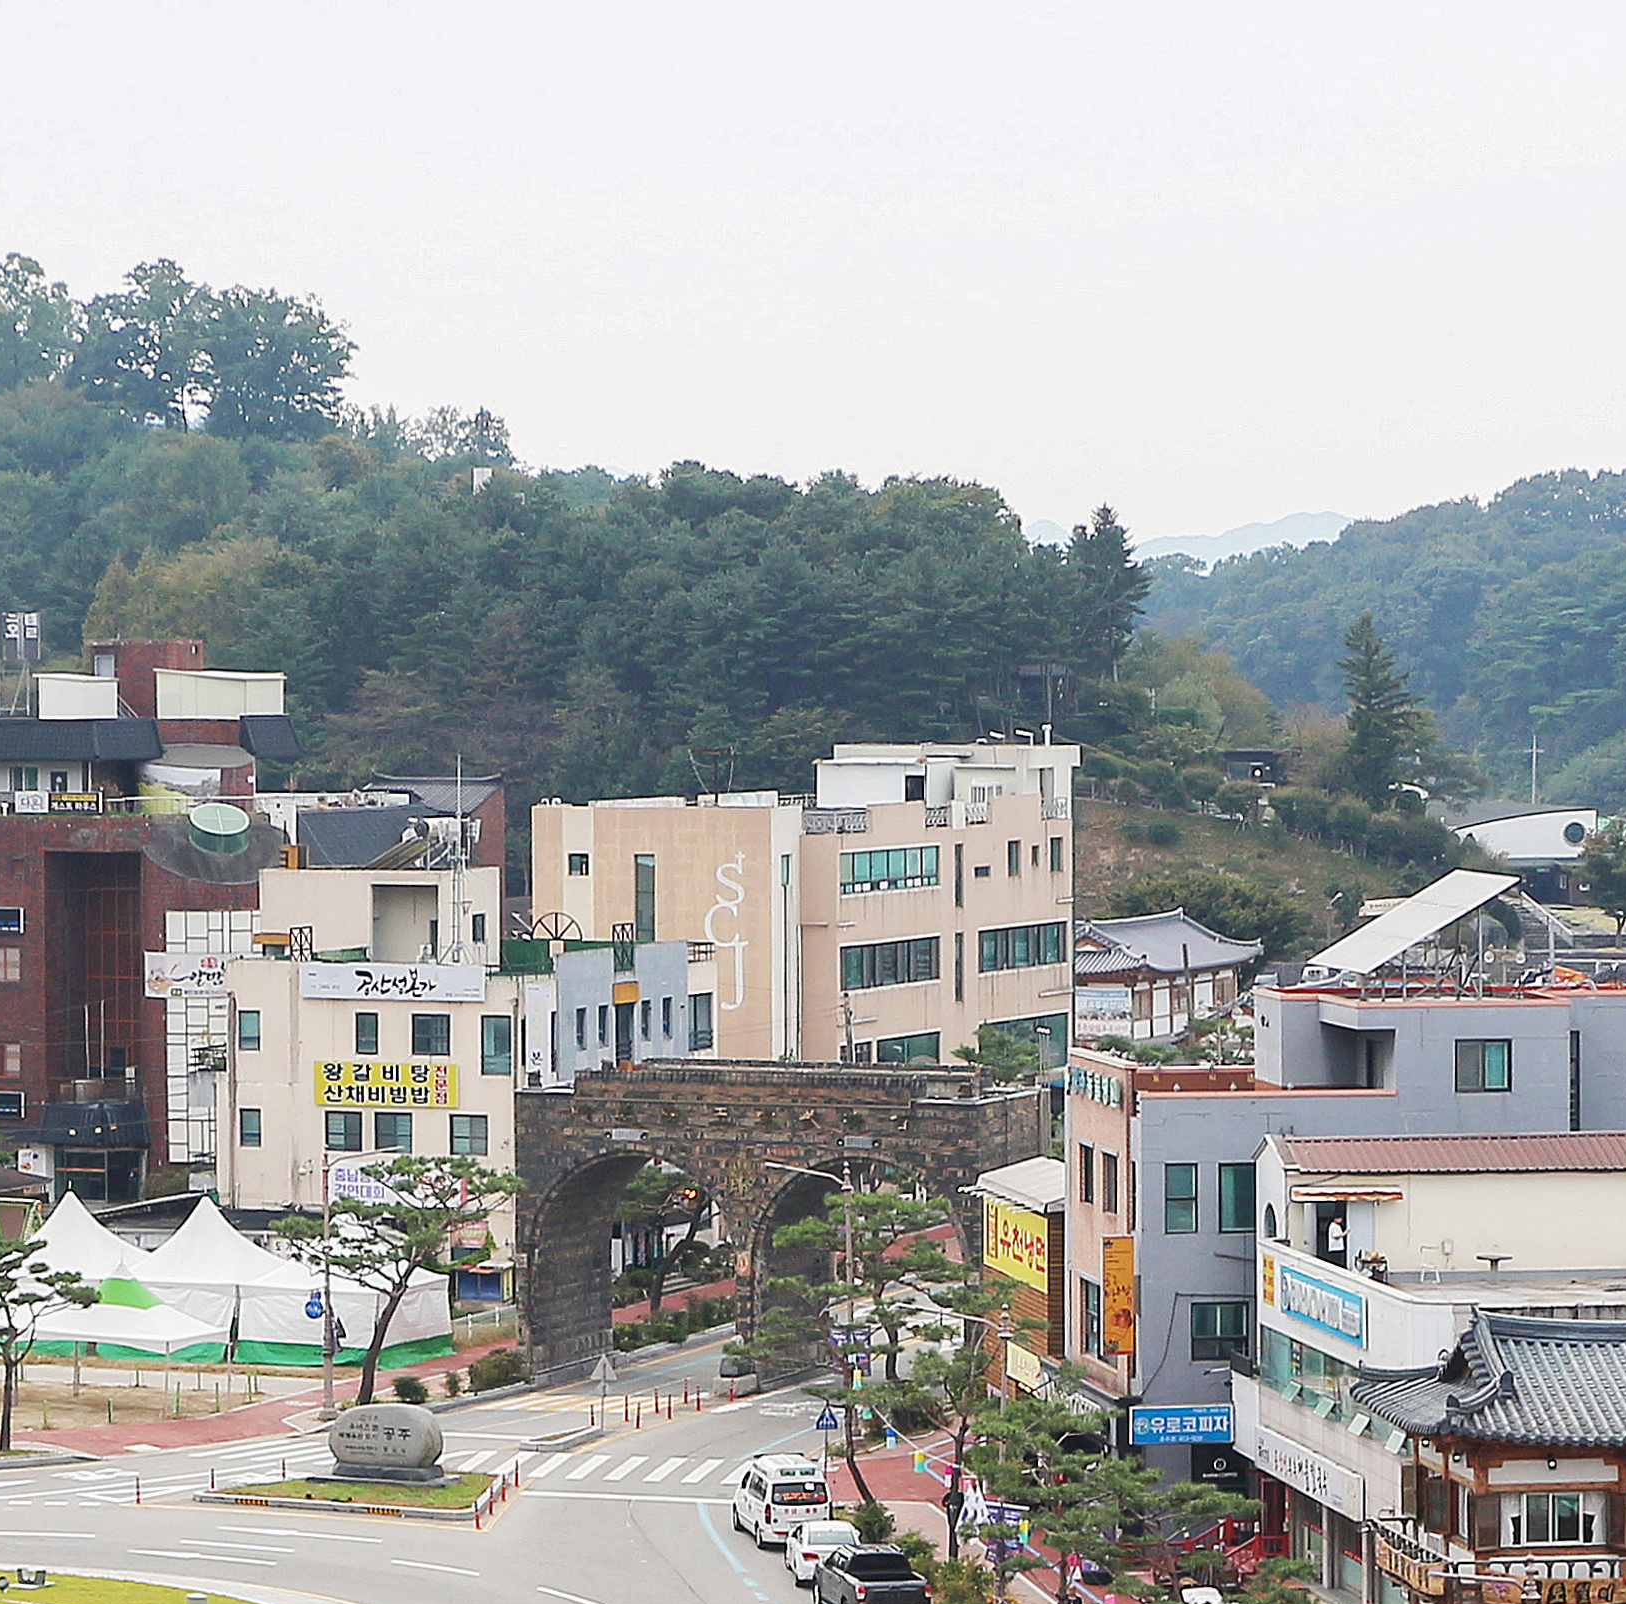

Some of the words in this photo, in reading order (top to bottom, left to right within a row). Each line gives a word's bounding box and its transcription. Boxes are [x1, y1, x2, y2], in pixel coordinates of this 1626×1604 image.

[434, 1065, 448, 1104] 전문점
[324, 1085, 431, 1104] 산채비빔밥
[1000, 1219, 1046, 1274] 유천냉면
[383, 1426, 412, 1441] 공주
[1150, 1416, 1230, 1434] 유로코피자
